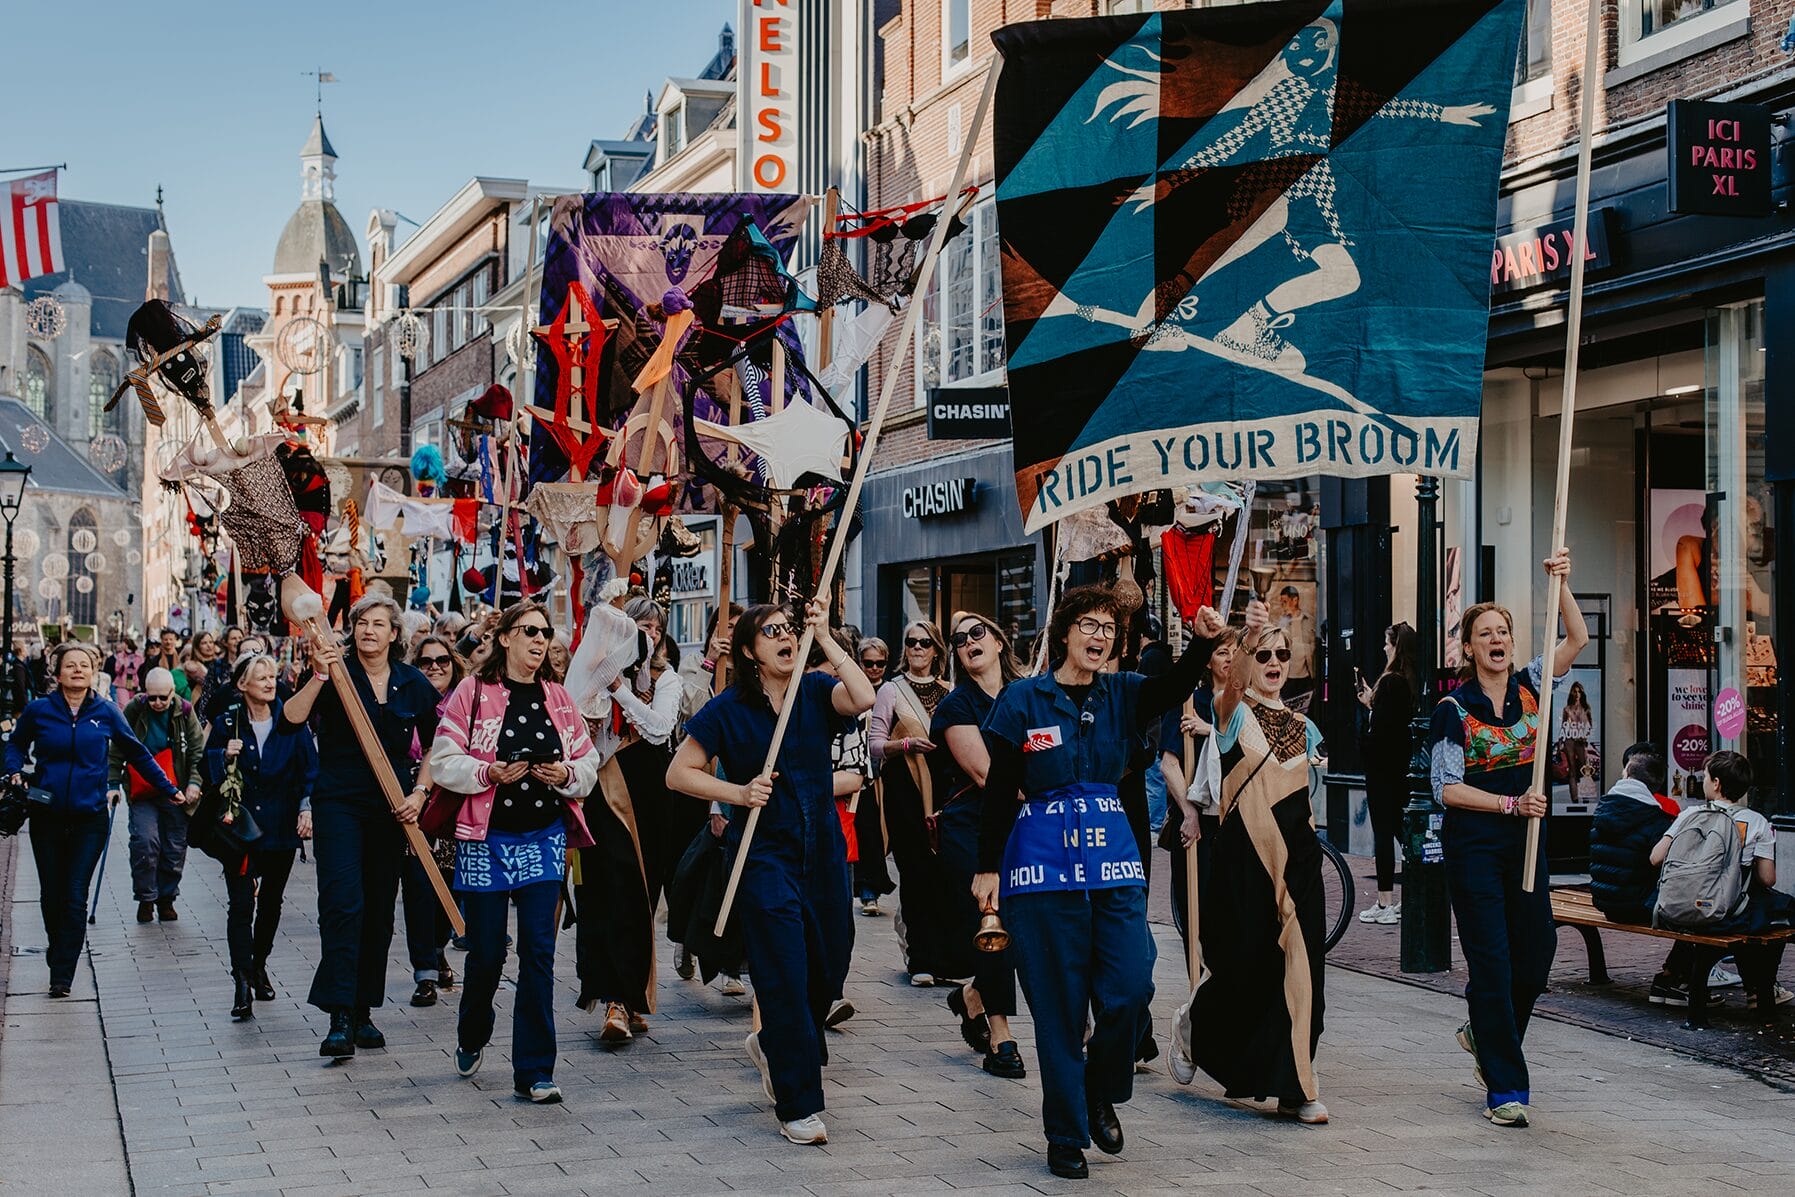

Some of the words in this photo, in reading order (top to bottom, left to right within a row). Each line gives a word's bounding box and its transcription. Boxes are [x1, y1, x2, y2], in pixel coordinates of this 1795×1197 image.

[753, 0, 788, 189] ELSO
[1707, 119, 1741, 142] ICI
[1691, 145, 1757, 170] PARIS
[1711, 174, 1740, 196] XL
[1491, 233, 1559, 285] PARIS
[1035, 444, 1133, 514] RIDE
[1151, 429, 1276, 475] YOUR
[1294, 420, 1460, 472] BROOM
[902, 478, 966, 519] CHASIN'
[1717, 694, 1741, 717] -20%
[1676, 739, 1708, 752] -20%
[459, 841, 491, 857] YES
[500, 842, 540, 857] YES
[459, 856, 492, 872] YES
[501, 850, 543, 870] YES
[460, 871, 493, 887] YES
[503, 863, 544, 885] YES
[1010, 864, 1045, 888] HOU
